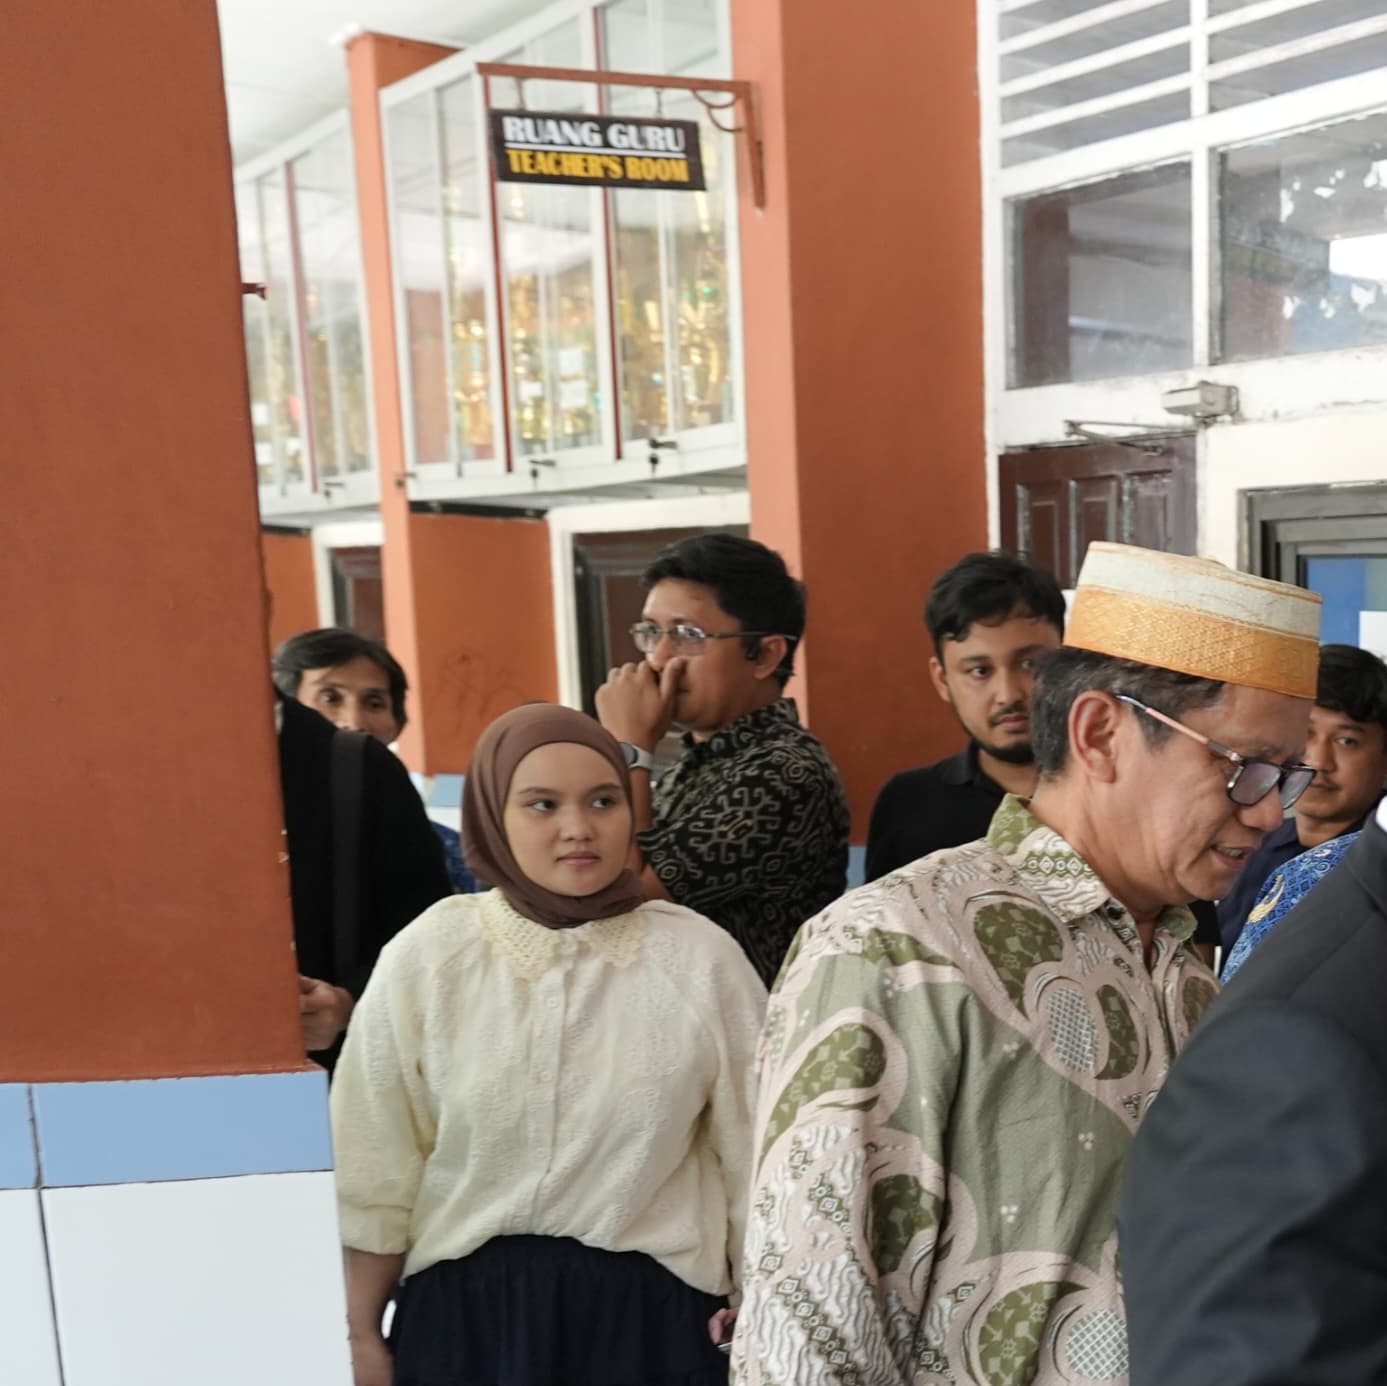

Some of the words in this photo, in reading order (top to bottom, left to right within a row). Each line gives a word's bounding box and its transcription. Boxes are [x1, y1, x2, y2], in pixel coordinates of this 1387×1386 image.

[502, 116, 603, 147] RUANG
[607, 123, 685, 152] GURU
[507, 149, 623, 179] TEACHER'S
[625, 157, 690, 183] ROOM
